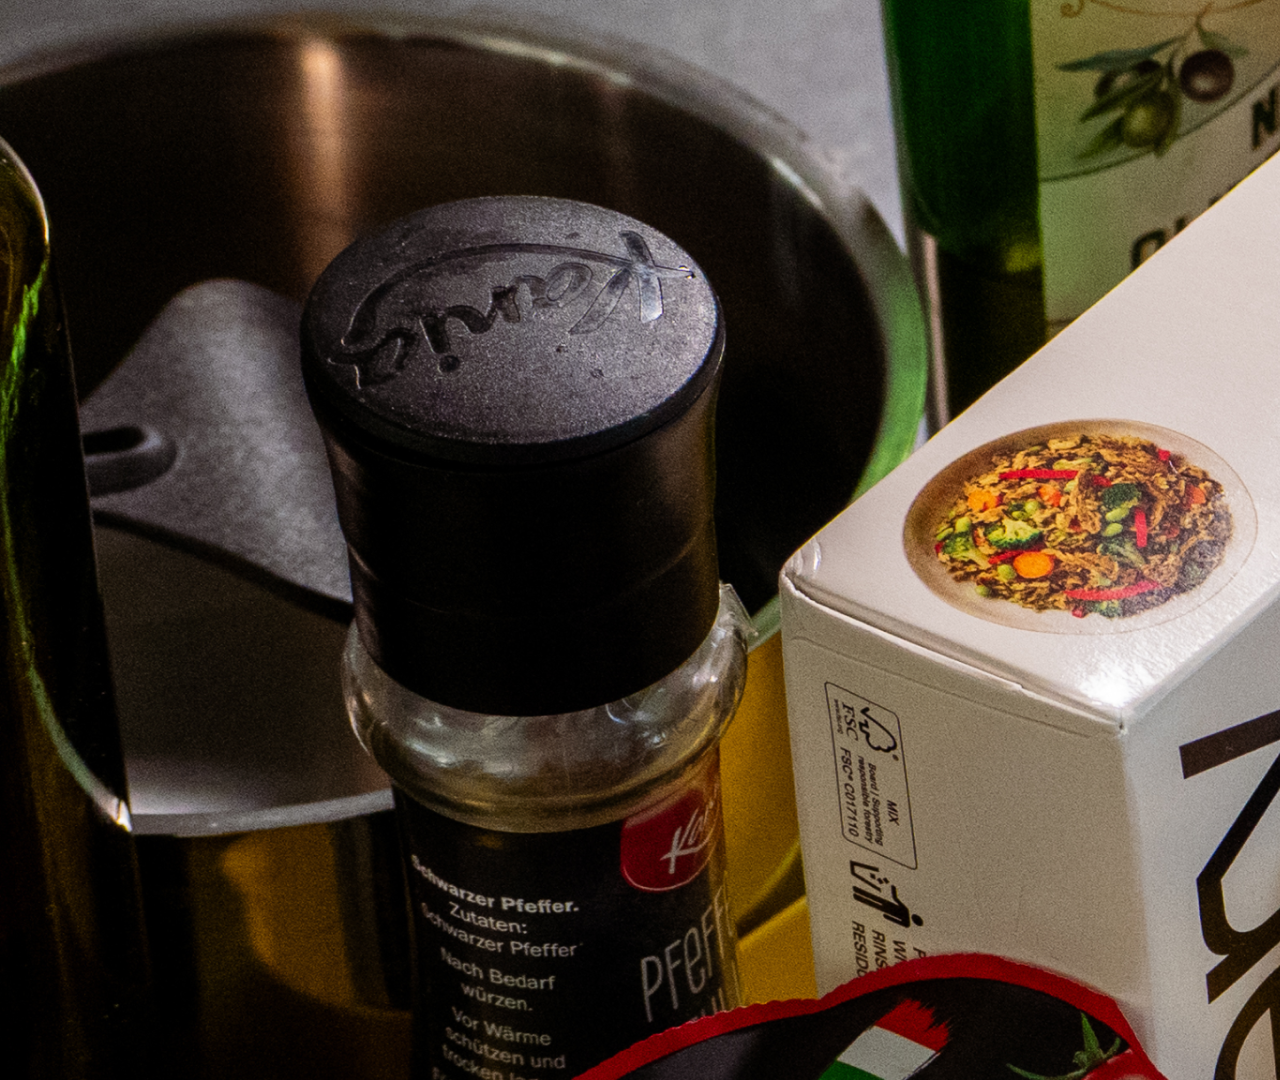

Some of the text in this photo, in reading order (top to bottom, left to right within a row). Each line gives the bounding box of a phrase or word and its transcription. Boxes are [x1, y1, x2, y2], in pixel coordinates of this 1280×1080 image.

[842, 702, 858, 742] FSC
[845, 784, 859, 837] C017110
[858, 755, 873, 845] responsible forestry
[868, 762, 884, 847] Board Supporting
[887, 799, 900, 826] MIX
[449, 901, 528, 934] Zutaten:
[501, 896, 579, 914] Pfeffer.
[440, 947, 556, 990] Nach Bedarf
[510, 940, 578, 958] Pfeffer
[461, 982, 533, 1012] würzen.
[452, 1006, 551, 1046] Vor Wärme
[445, 1026, 566, 1070] schützen und
